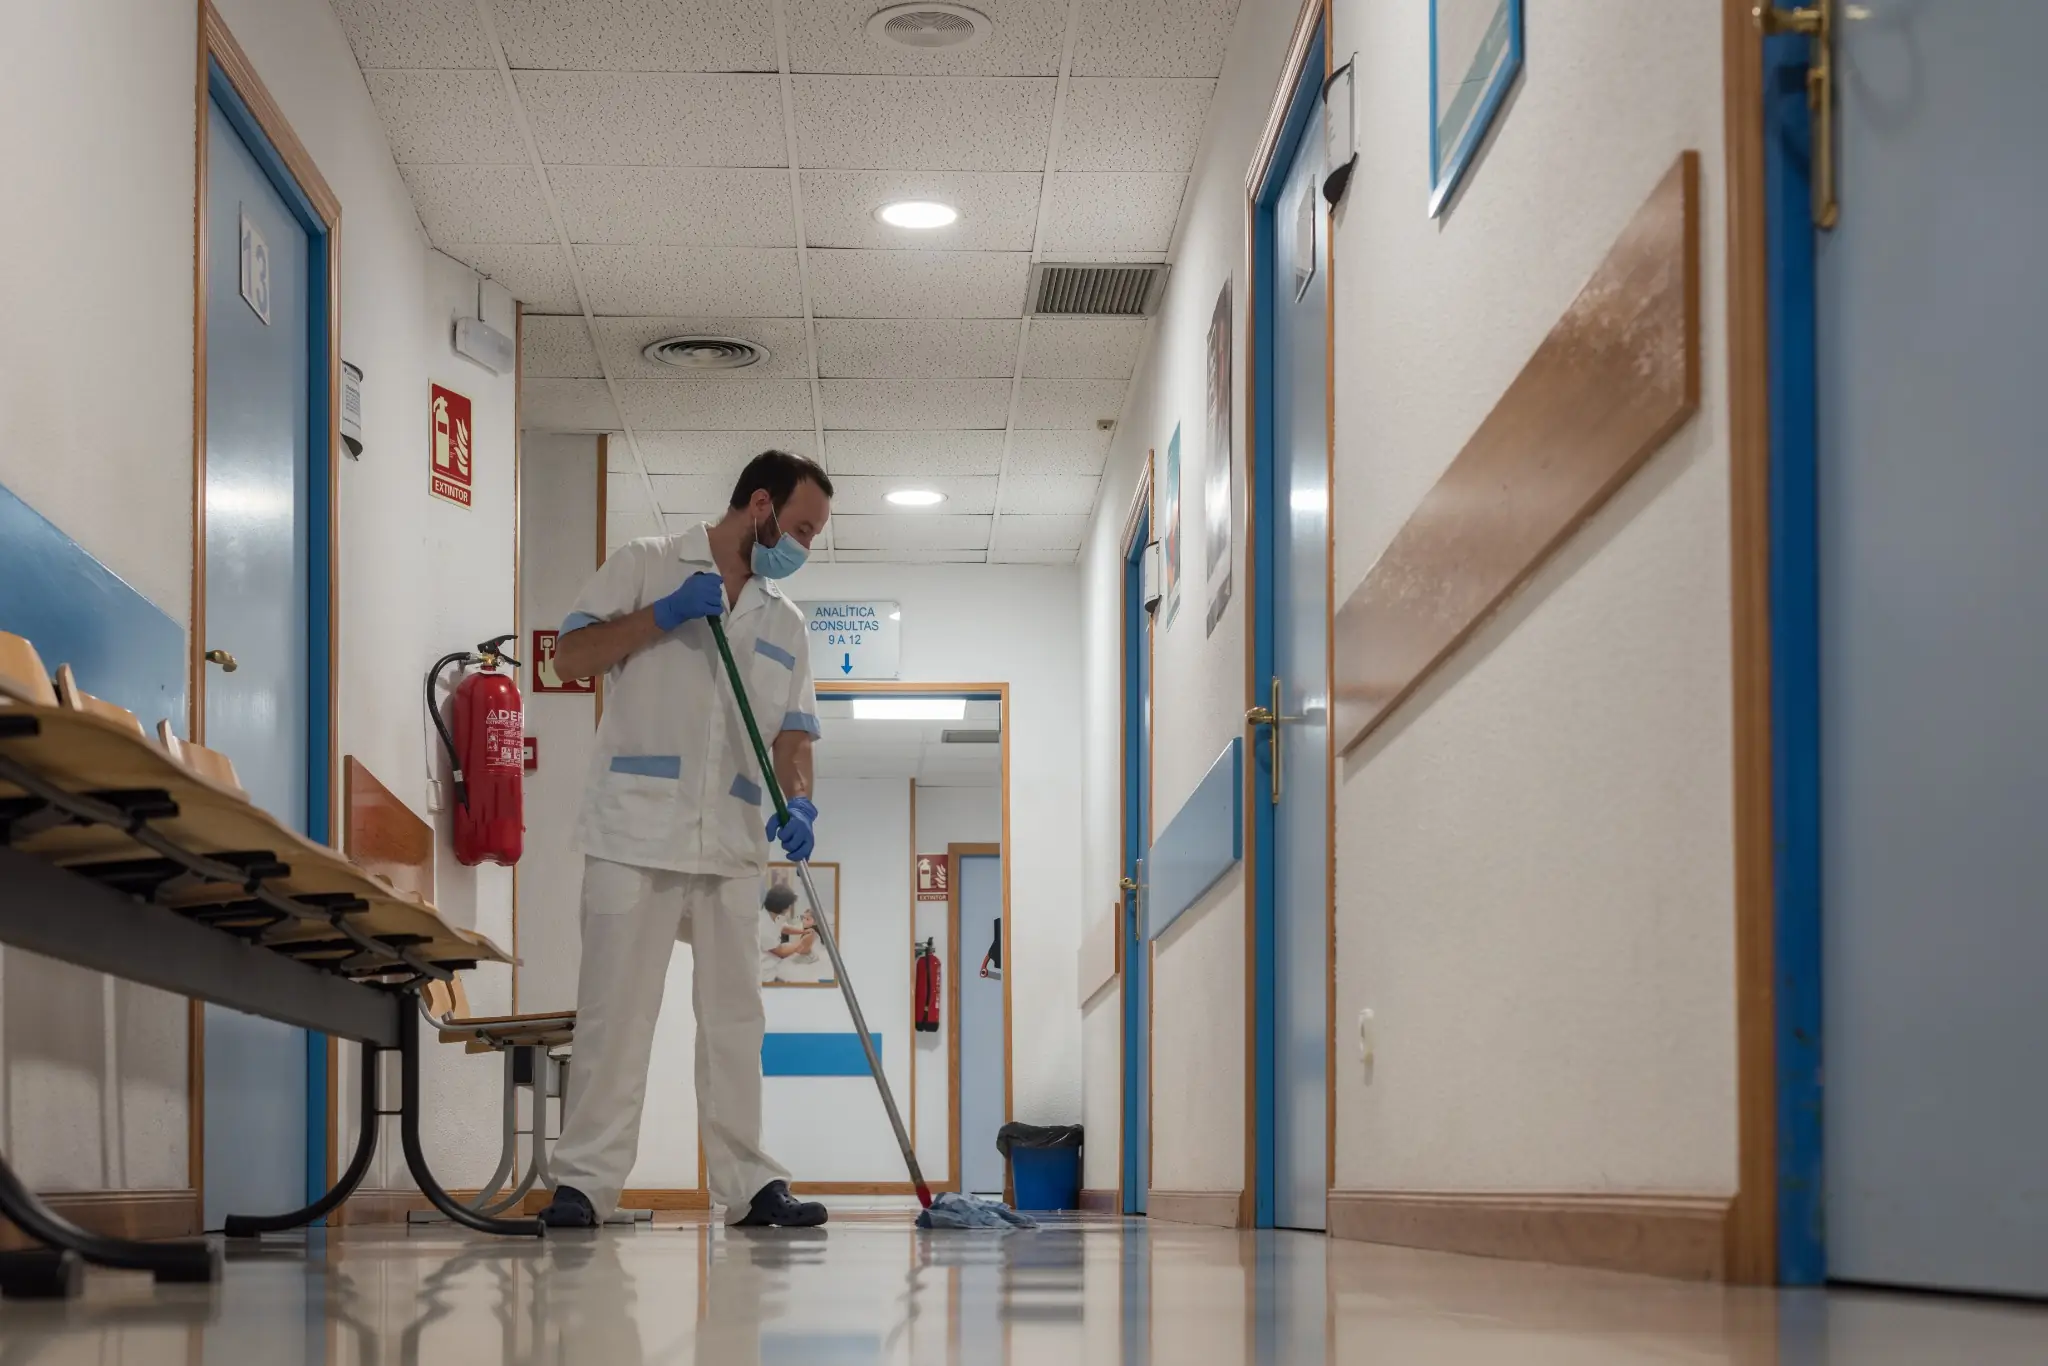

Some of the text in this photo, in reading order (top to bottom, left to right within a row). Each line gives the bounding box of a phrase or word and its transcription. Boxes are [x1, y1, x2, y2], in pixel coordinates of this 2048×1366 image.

[242, 229, 267, 313] 13
[435, 480, 468, 502] EXTINTOR
[815, 604, 875, 617] ANALÍTICA
[810, 620, 879, 631] CONSULTAS
[828, 634, 861, 645] 9 A 12
